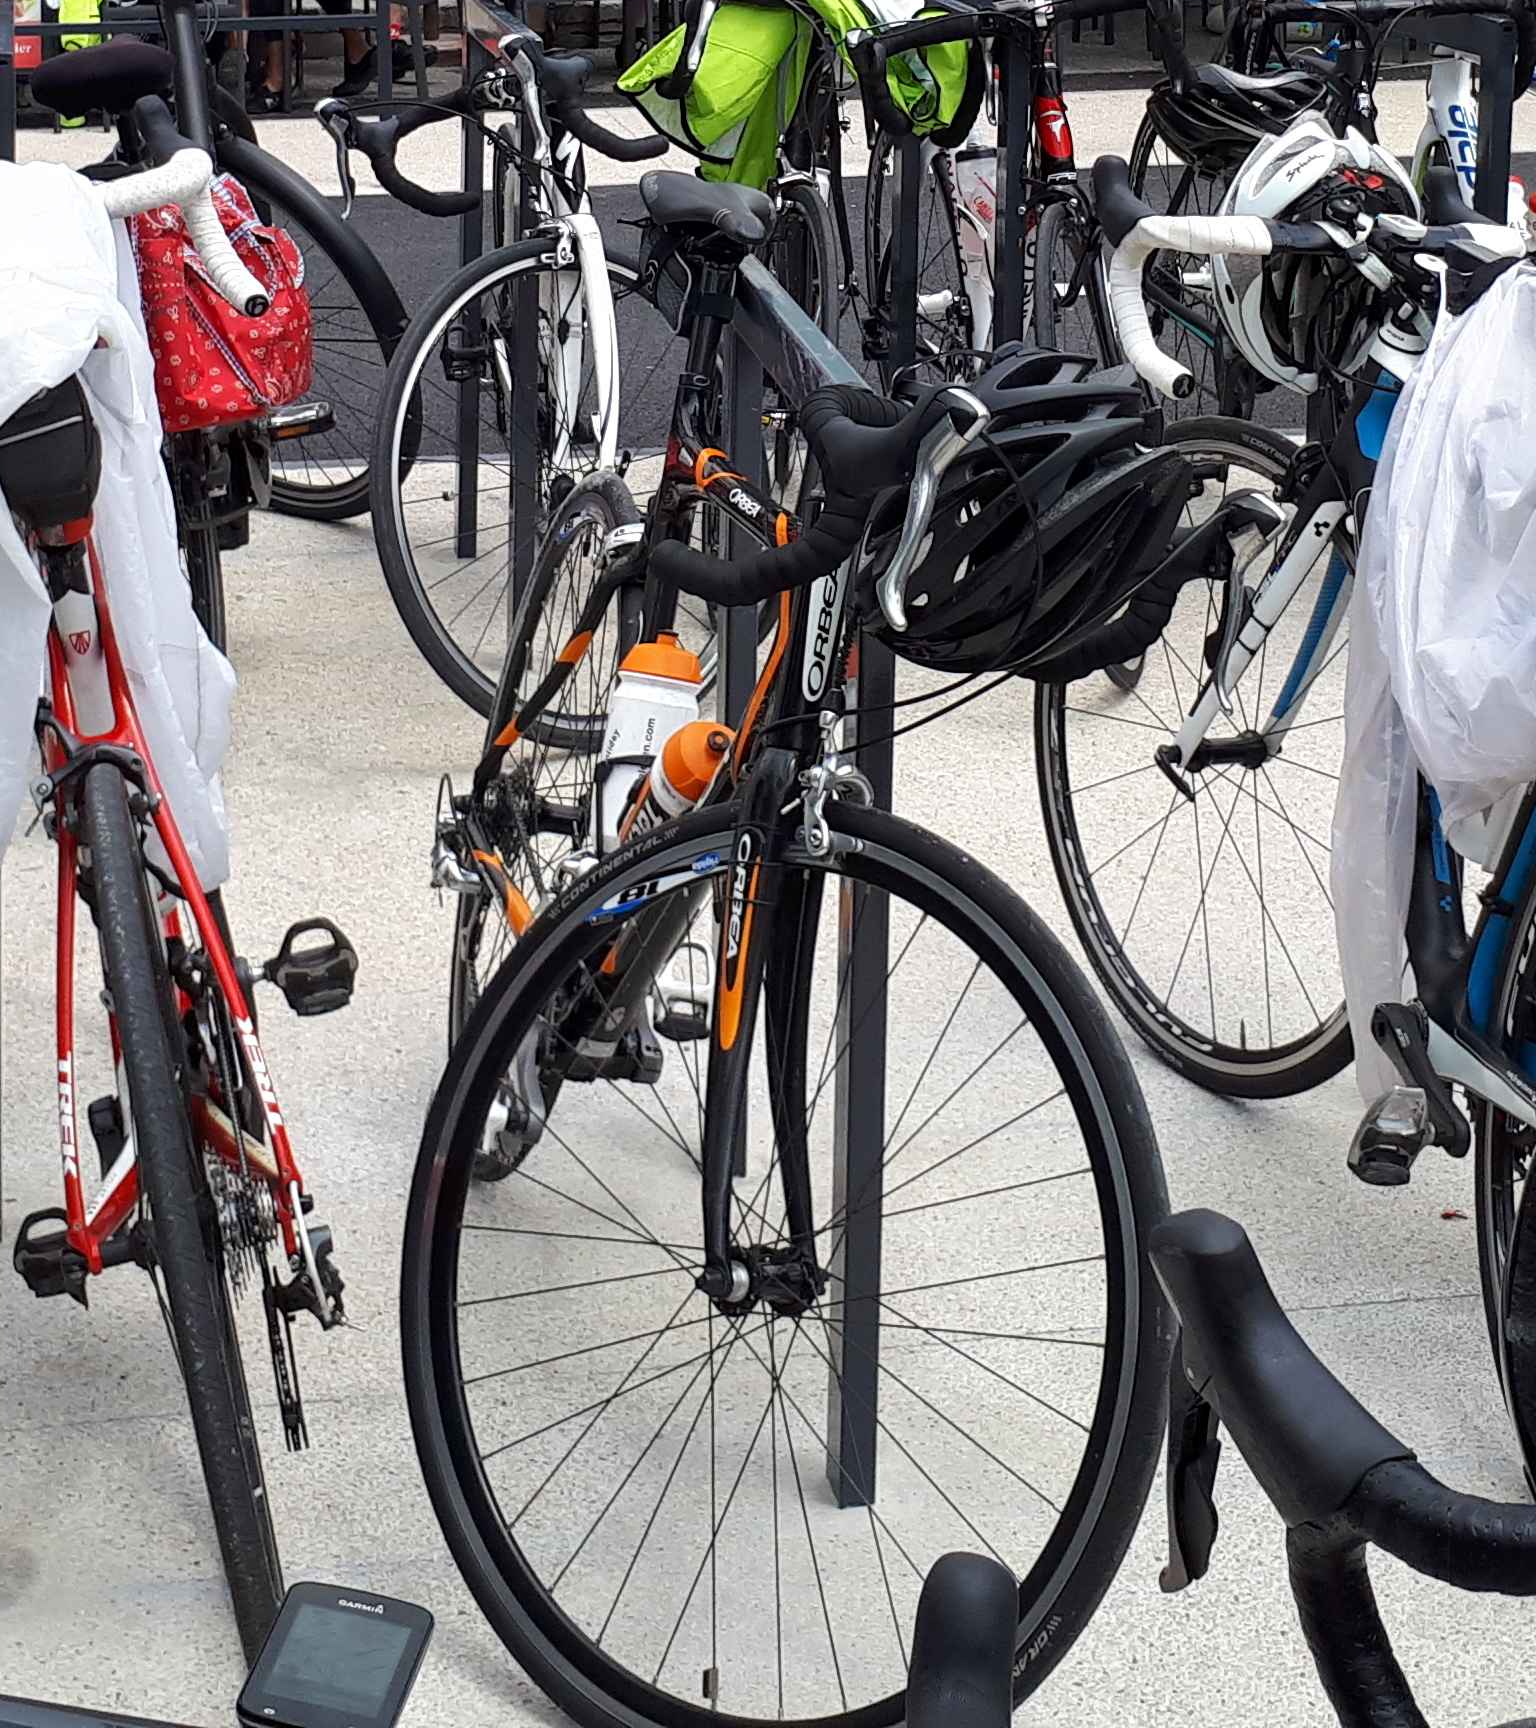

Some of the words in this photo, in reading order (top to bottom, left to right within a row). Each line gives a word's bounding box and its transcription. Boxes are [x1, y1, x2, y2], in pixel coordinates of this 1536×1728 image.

[729, 488, 762, 518] ORBEA
[560, 836, 665, 910] CONTINENTAL
[724, 833, 752, 960] ORBEA
[58, 1050, 80, 1180] TREK
[236, 1016, 286, 1136] TREK
[337, 1599, 384, 1615] GARMIN
